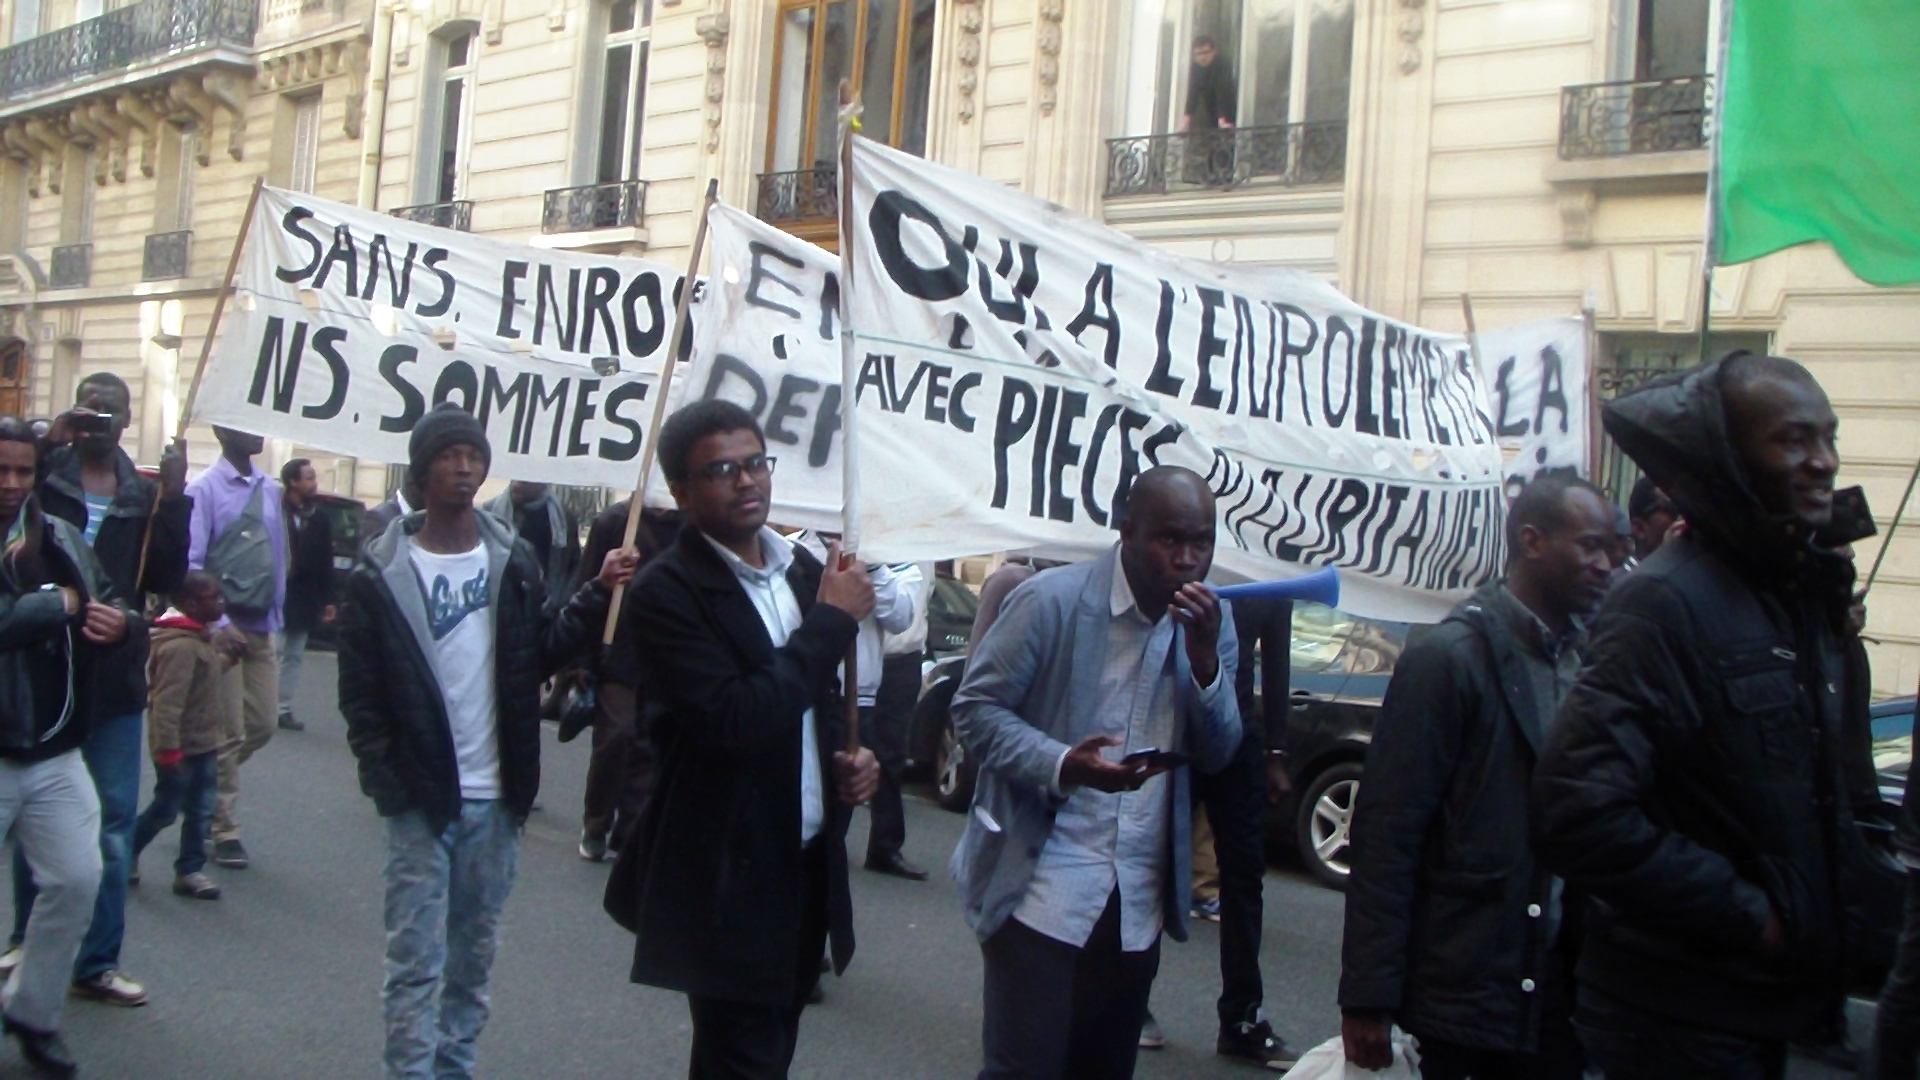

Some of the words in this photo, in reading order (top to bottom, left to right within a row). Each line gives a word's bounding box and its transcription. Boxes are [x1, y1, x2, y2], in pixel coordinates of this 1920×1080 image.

[1066, 262, 1120, 370] A
[378, 343, 649, 462] SOMMES
[855, 352, 982, 432] AVEC
